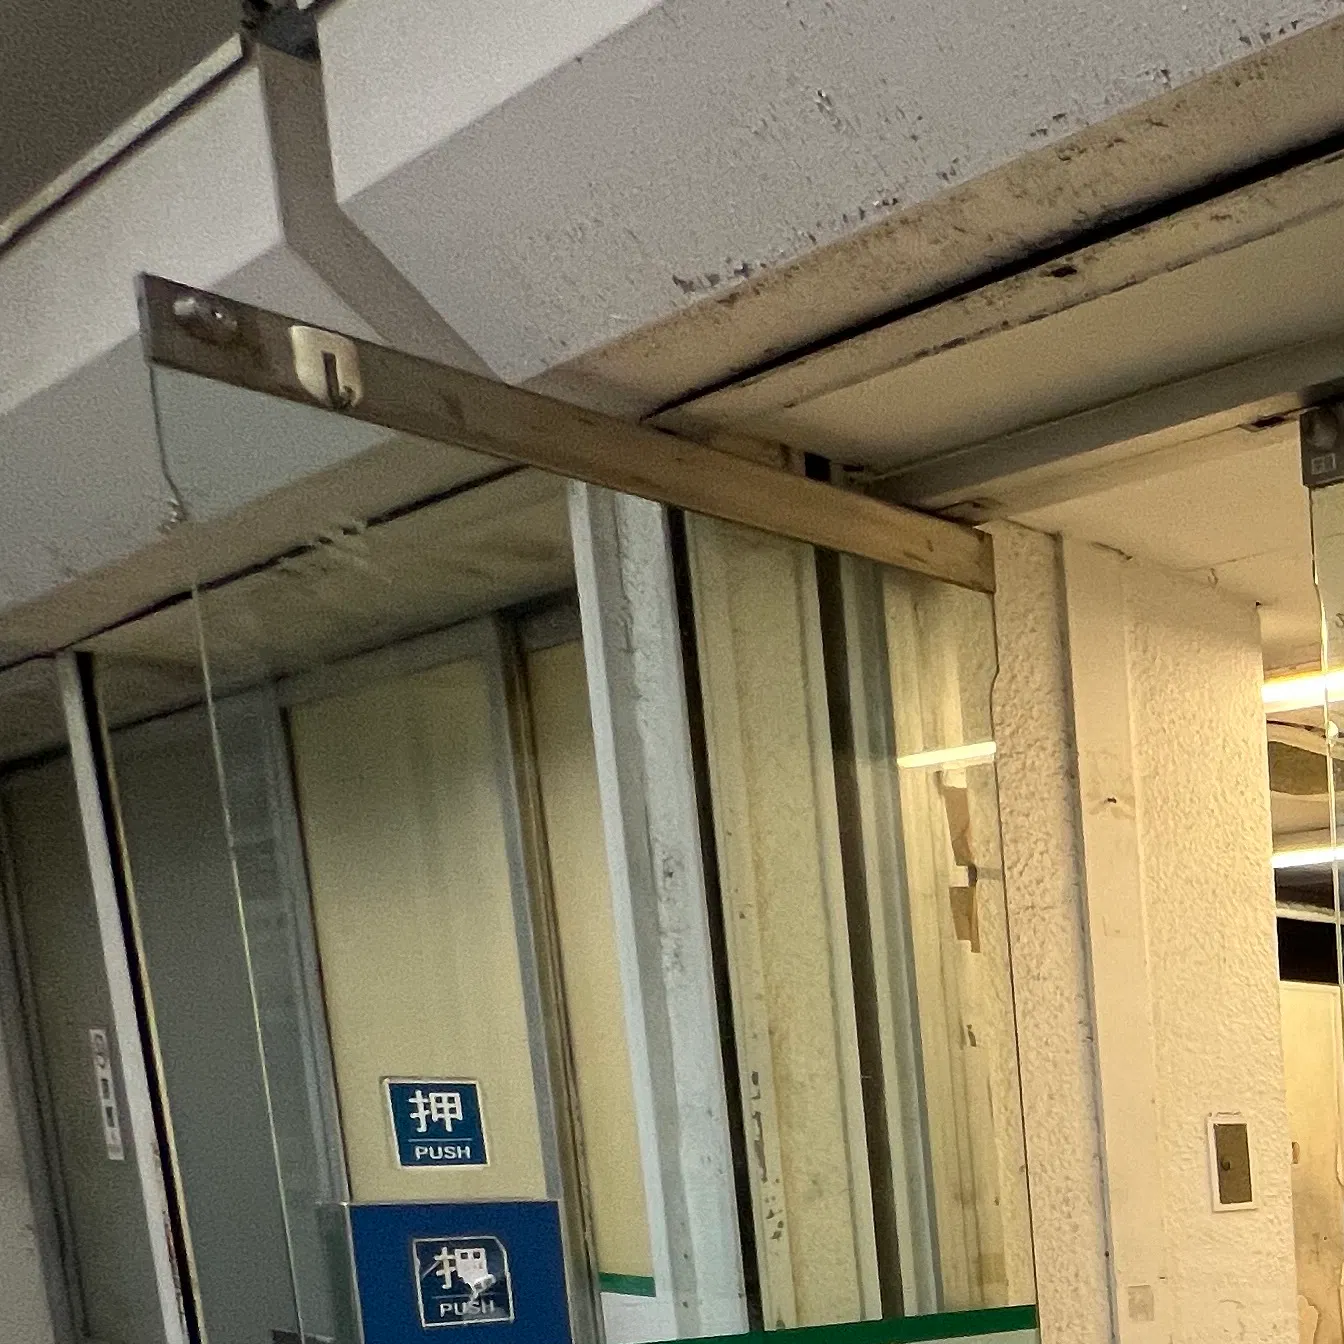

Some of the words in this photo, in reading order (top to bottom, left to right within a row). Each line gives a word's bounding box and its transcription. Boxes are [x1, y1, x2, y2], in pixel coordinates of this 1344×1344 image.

[407, 1089, 463, 1133] 押
[415, 1145, 472, 1161] PUSH
[439, 1301, 495, 1317] PUSH
